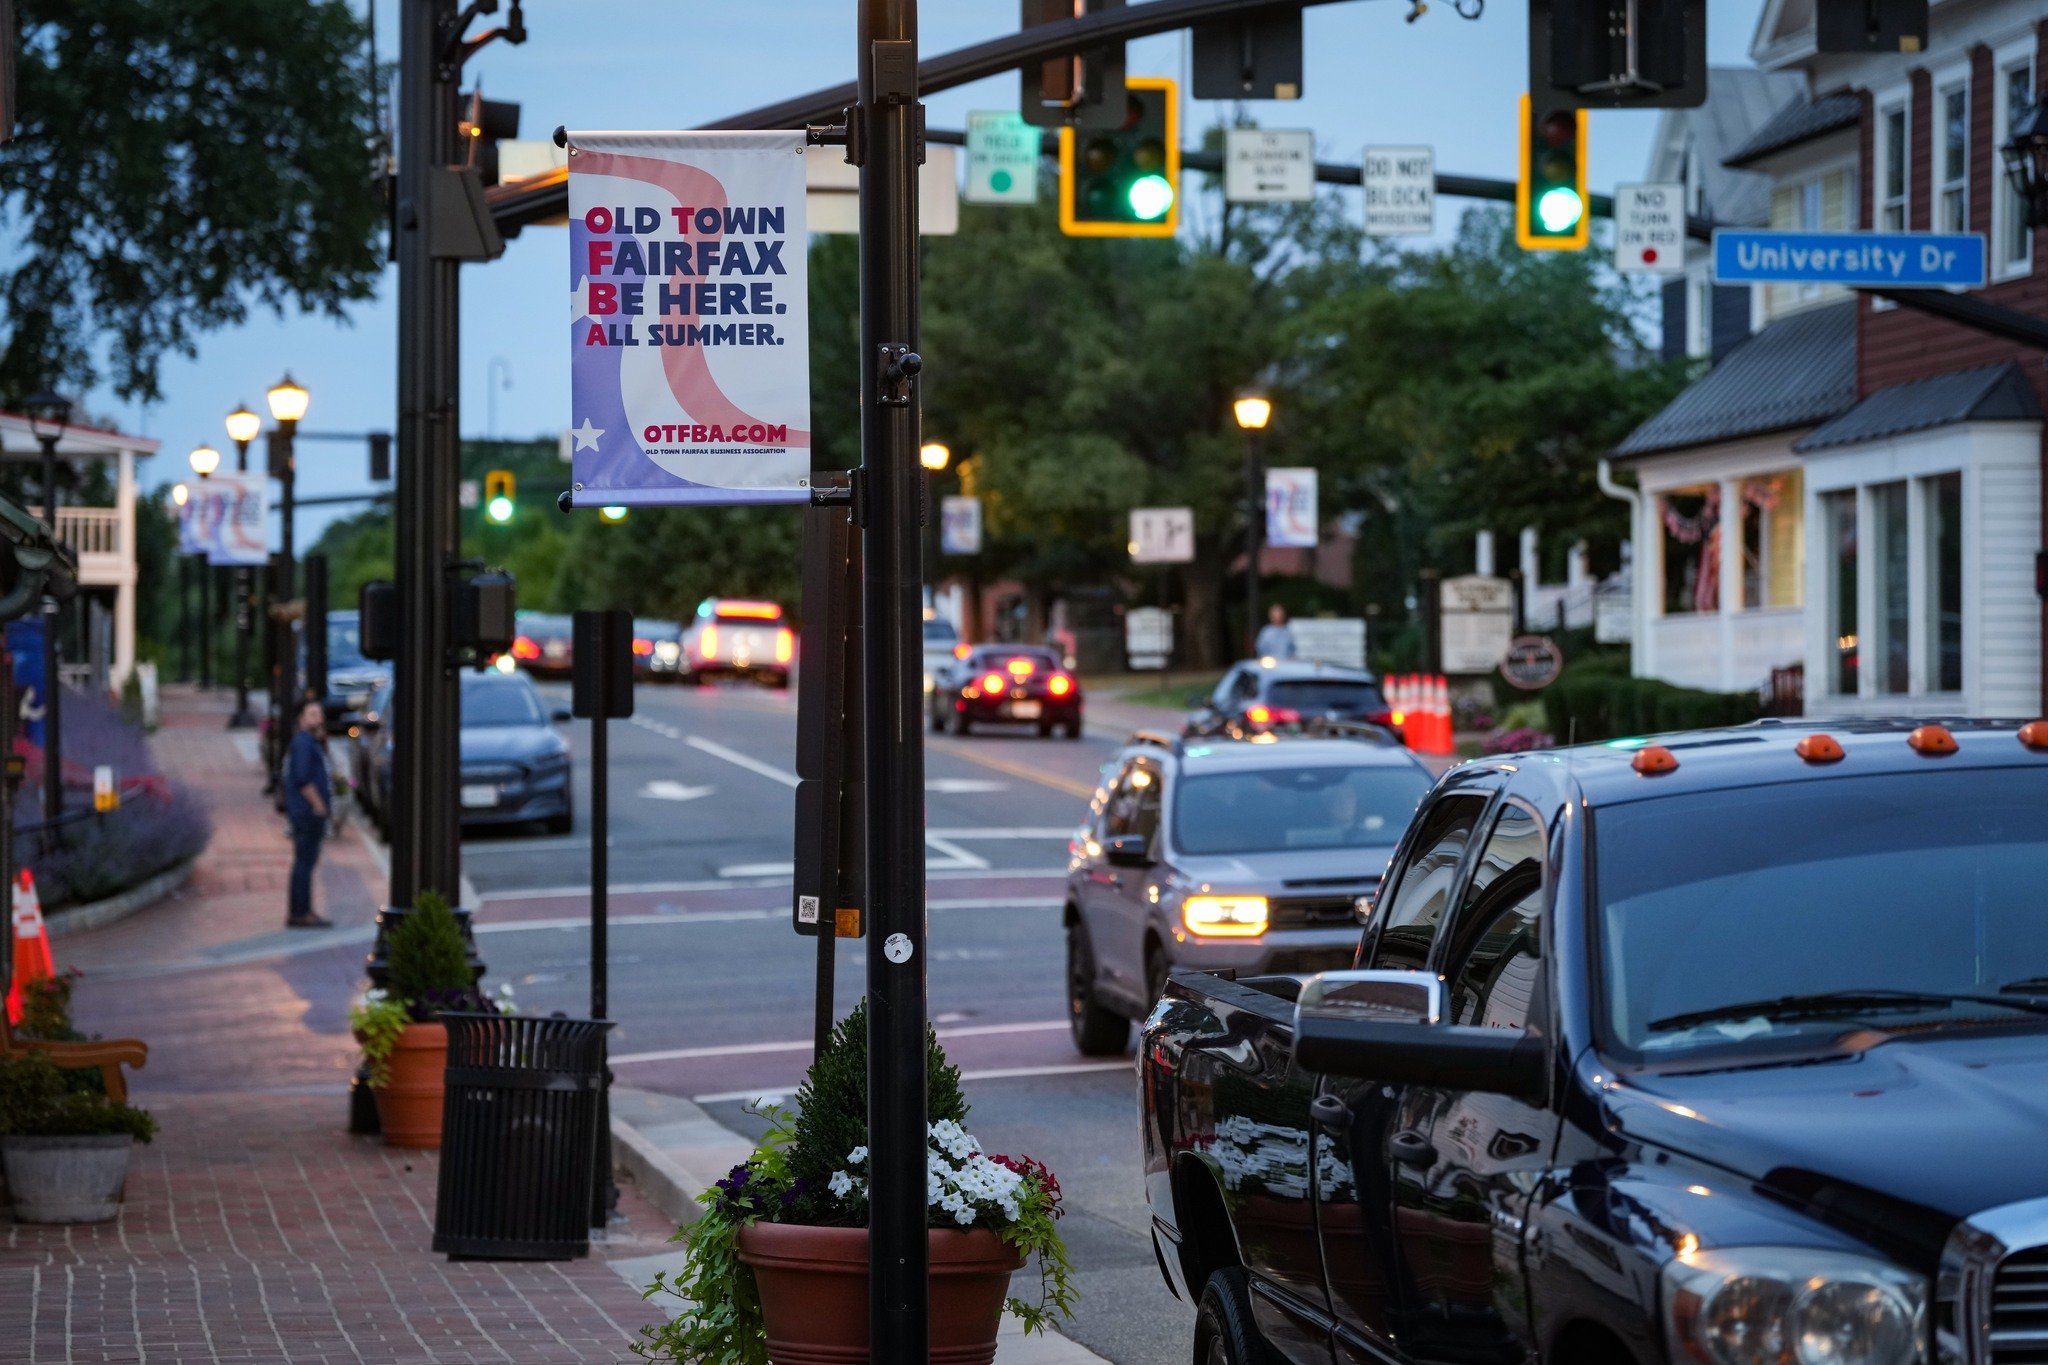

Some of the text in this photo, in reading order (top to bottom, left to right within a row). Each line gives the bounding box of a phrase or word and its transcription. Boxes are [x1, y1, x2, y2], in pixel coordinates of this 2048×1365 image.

[1366, 157, 1430, 178] DO NOT
[1366, 186, 1431, 206] BLOCK
[1634, 190, 1667, 209] NO
[585, 206, 785, 235] OLD TOWN
[1630, 211, 1671, 227] TURN
[1621, 229, 1678, 245] ON RED
[588, 240, 788, 276] FAIRFAX
[1737, 241, 1957, 278] University Dr
[588, 282, 788, 315] BE HERE.
[586, 323, 785, 346] ALL SUMMER.
[643, 424, 787, 443] OTFBA.COM
